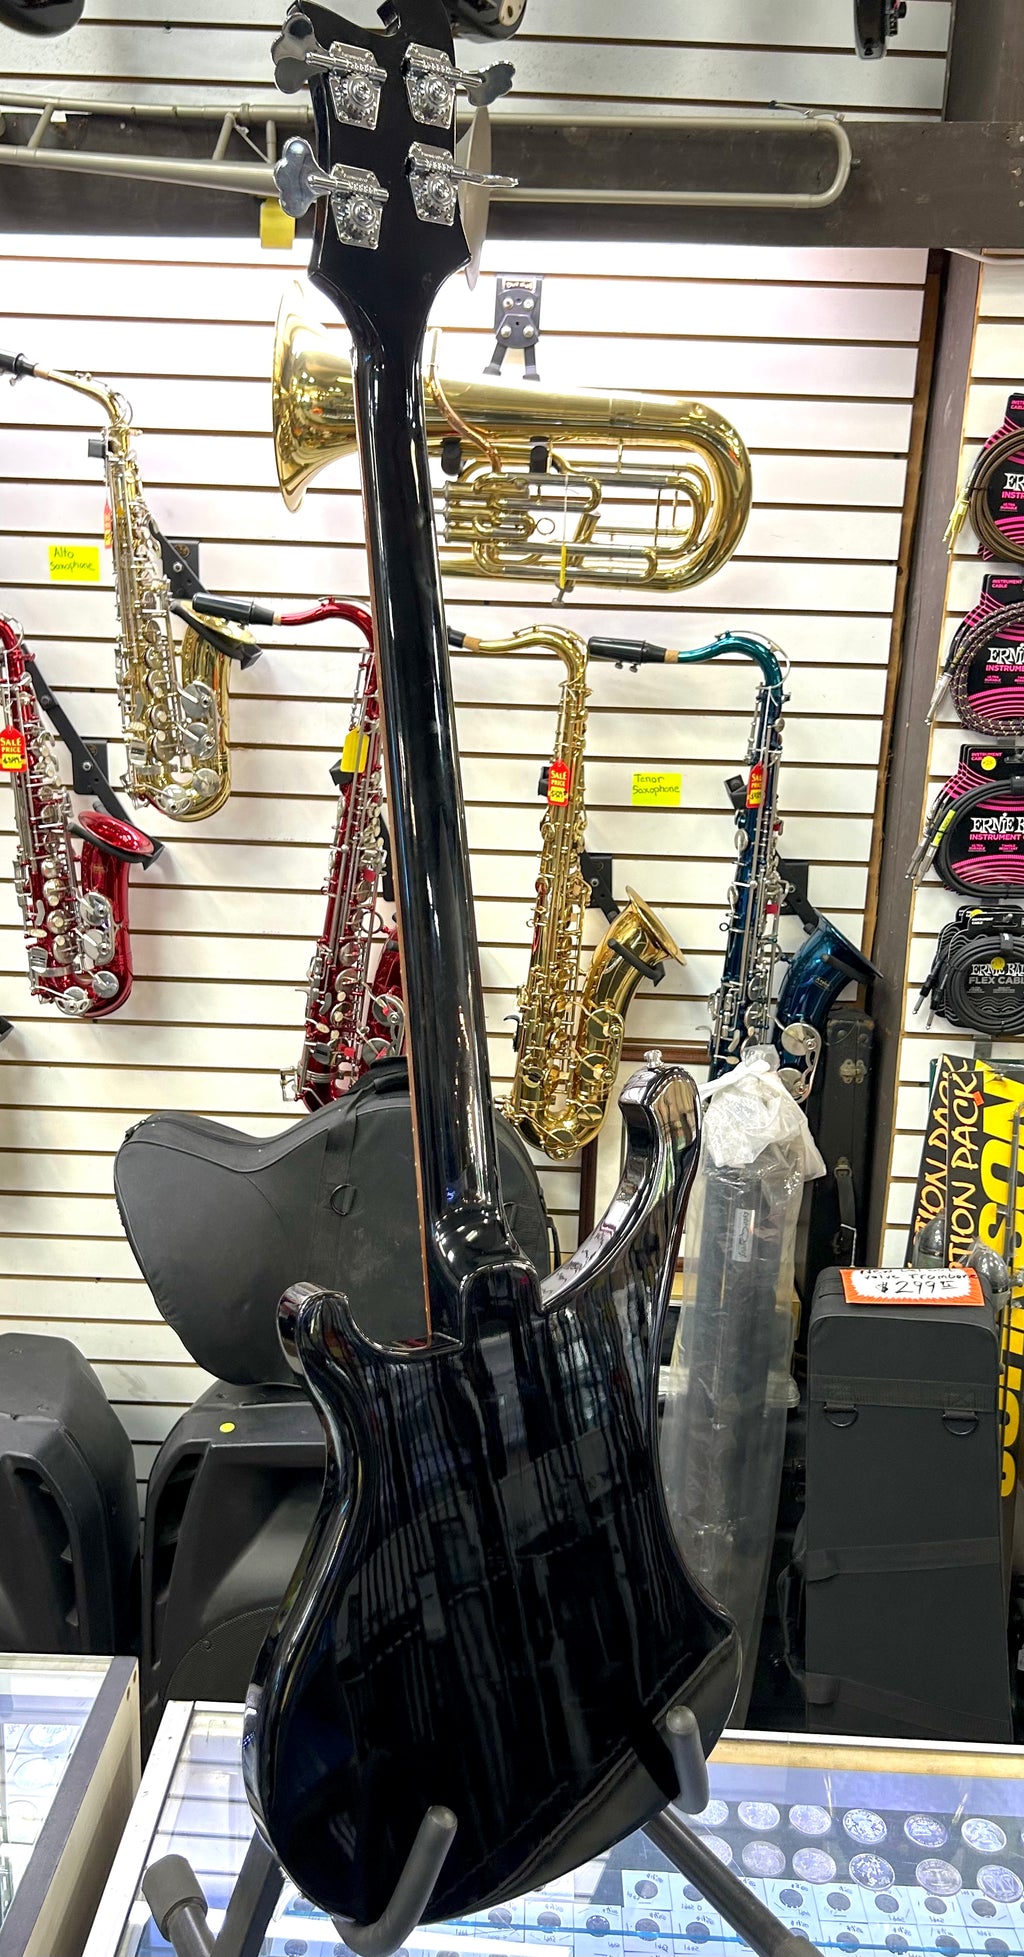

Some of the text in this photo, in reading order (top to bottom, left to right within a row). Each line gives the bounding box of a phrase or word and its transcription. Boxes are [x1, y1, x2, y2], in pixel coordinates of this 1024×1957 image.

[54, 547, 75, 559] Alto
[987, 643, 1024, 665] ERNI
[0, 737, 22, 747] SALE
[551, 770, 567, 780] SALE
[633, 774, 665, 784] Tenor
[551, 779, 566, 787] PRICE
[632, 785, 680, 796] Saxophone
[970, 812, 1015, 834] ERNIE
[968, 976, 995, 985] FLEX
[951, 1072, 978, 1170] PACK
[949, 1180, 977, 1268] TION
